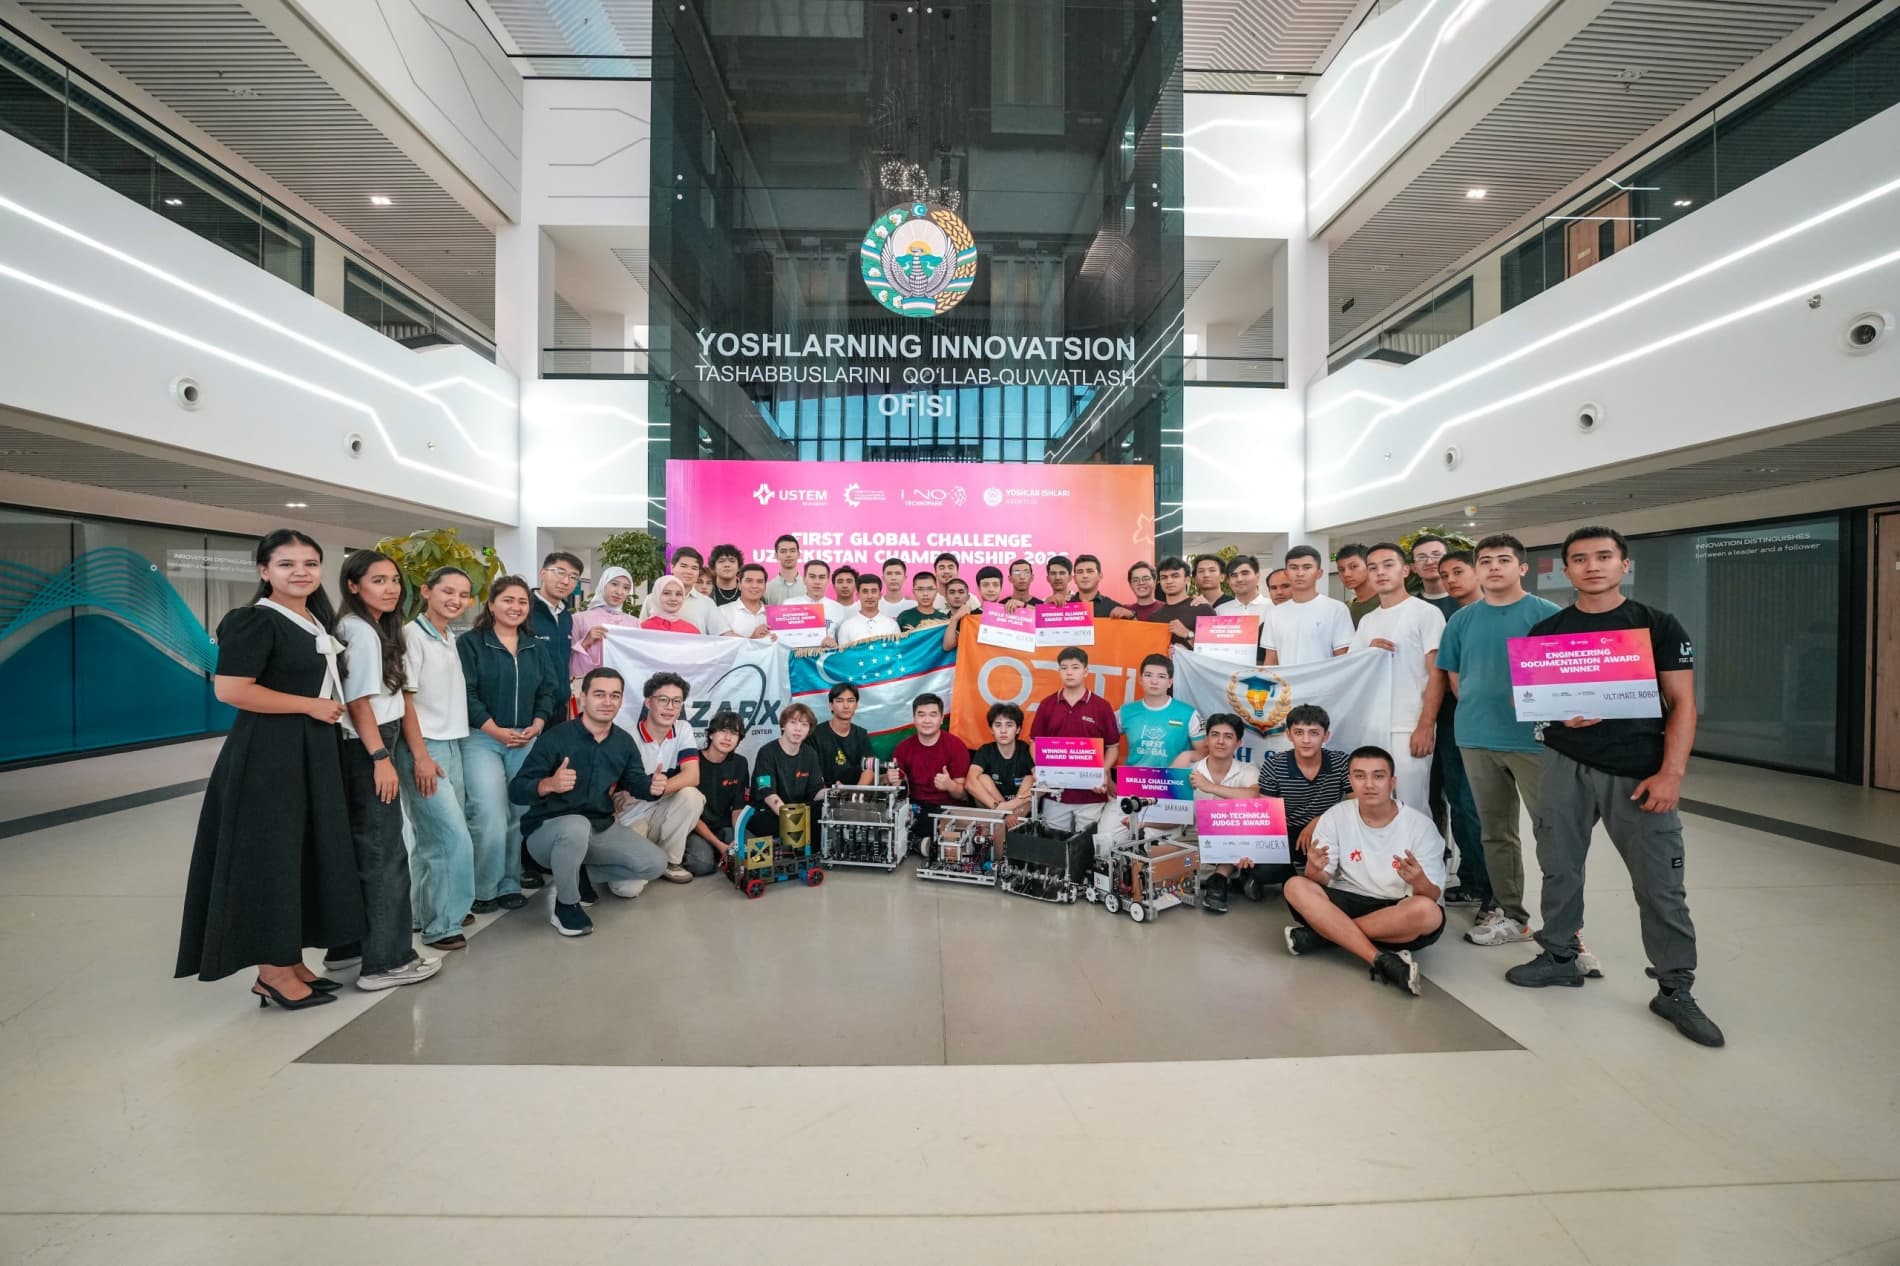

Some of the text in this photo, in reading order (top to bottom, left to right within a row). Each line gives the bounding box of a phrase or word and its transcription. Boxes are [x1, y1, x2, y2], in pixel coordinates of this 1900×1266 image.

[696, 332, 1135, 361] YOSHLARNING INNOVATSION
[695, 365, 890, 383] TASHABBUSLARINI
[878, 393, 952, 417] OFISI
[778, 489, 828, 501] USTEM
[850, 532, 920, 546] GLOBAL
[926, 532, 1033, 547] CHALLENGE
[1696, 532, 1811, 550] INNOVATION DISTINGUISHES
[1734, 548, 1758, 556] leader
[1760, 545, 1776, 553] and
[1784, 543, 1821, 551] follower
[1545, 648, 1611, 659] ENGINEERING
[1520, 654, 1640, 668] DOCUMENTATION AWARD
[1560, 664, 1600, 673] WINNER
[1603, 691, 1637, 700] ULTIMATE
[1141, 740, 1165, 748] FIRST
[1136, 747, 1168, 757] GLOBAL
[1148, 778, 1185, 786] CHALLENGE
[1211, 819, 1240, 827] JUDGES
